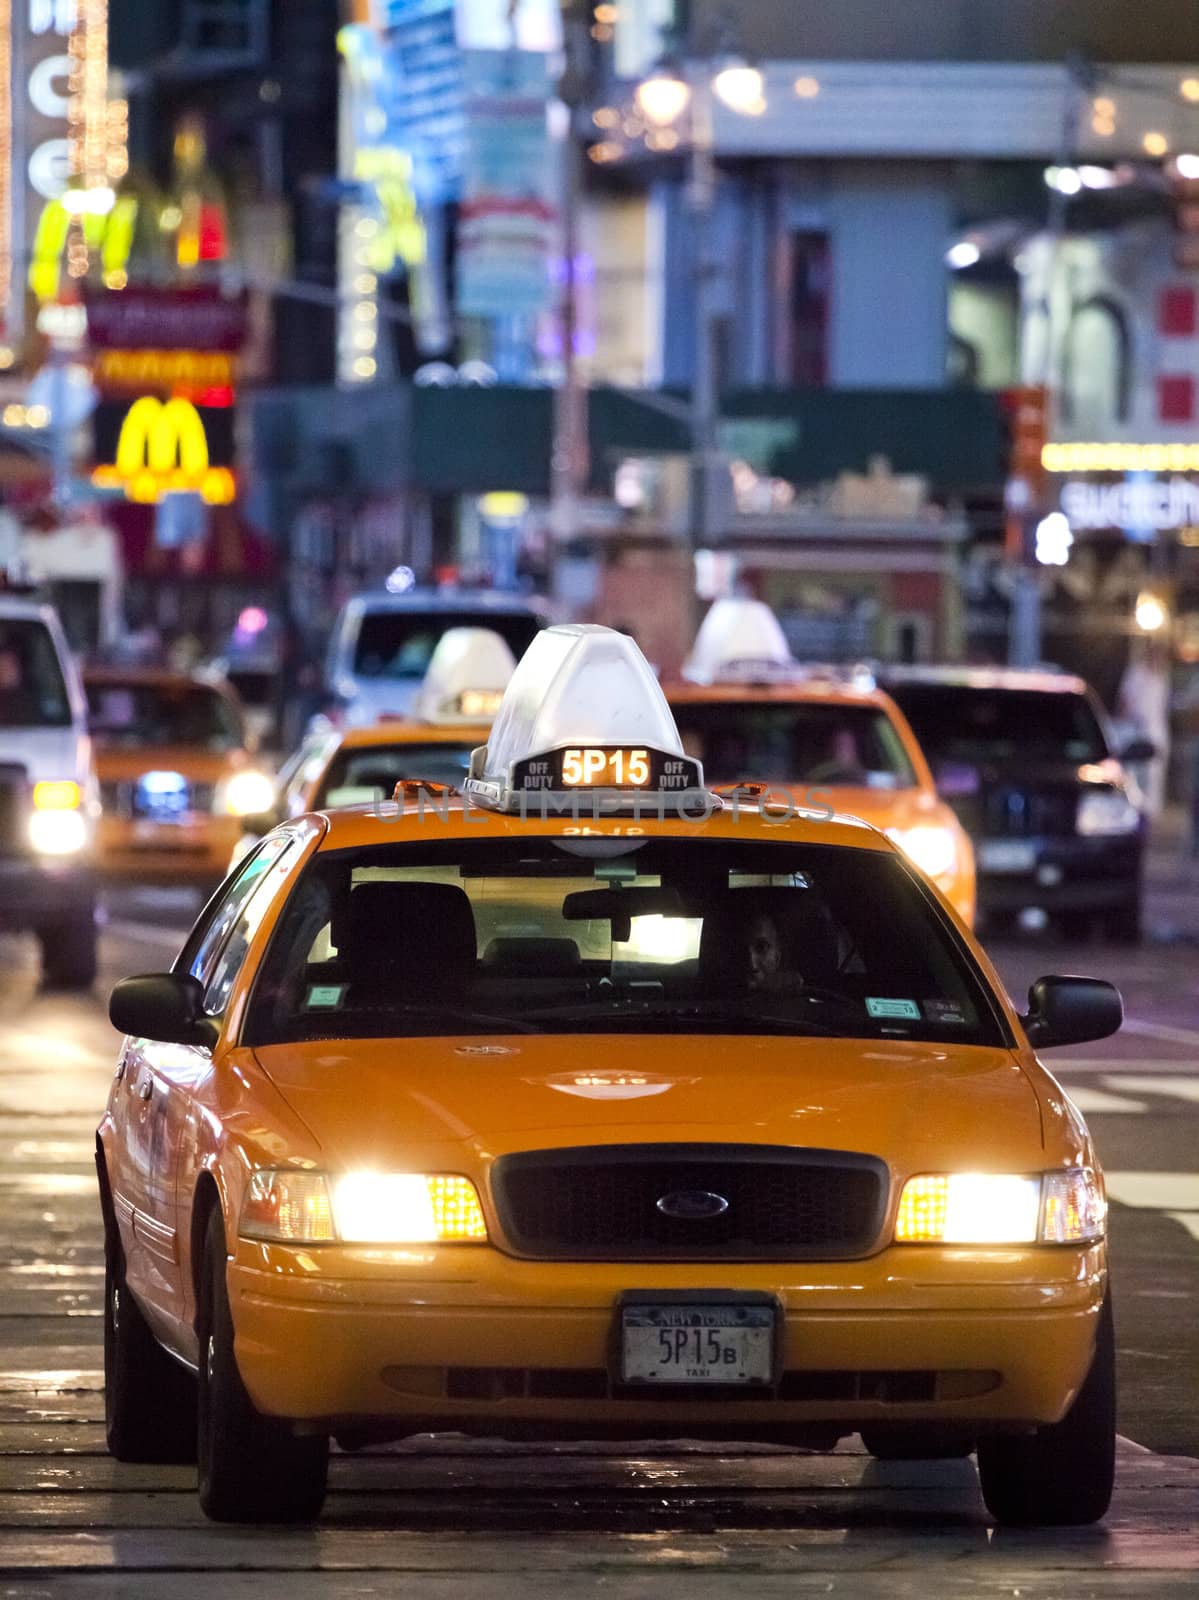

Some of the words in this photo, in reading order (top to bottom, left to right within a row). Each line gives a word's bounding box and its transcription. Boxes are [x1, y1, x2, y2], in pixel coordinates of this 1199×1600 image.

[528, 762, 548, 775] OFF
[562, 749, 649, 785] 5P15
[663, 761, 684, 775] OFF
[524, 775, 553, 789] DUTY
[659, 774, 689, 788] DUTY
[685, 1368, 711, 1377] TAXI
